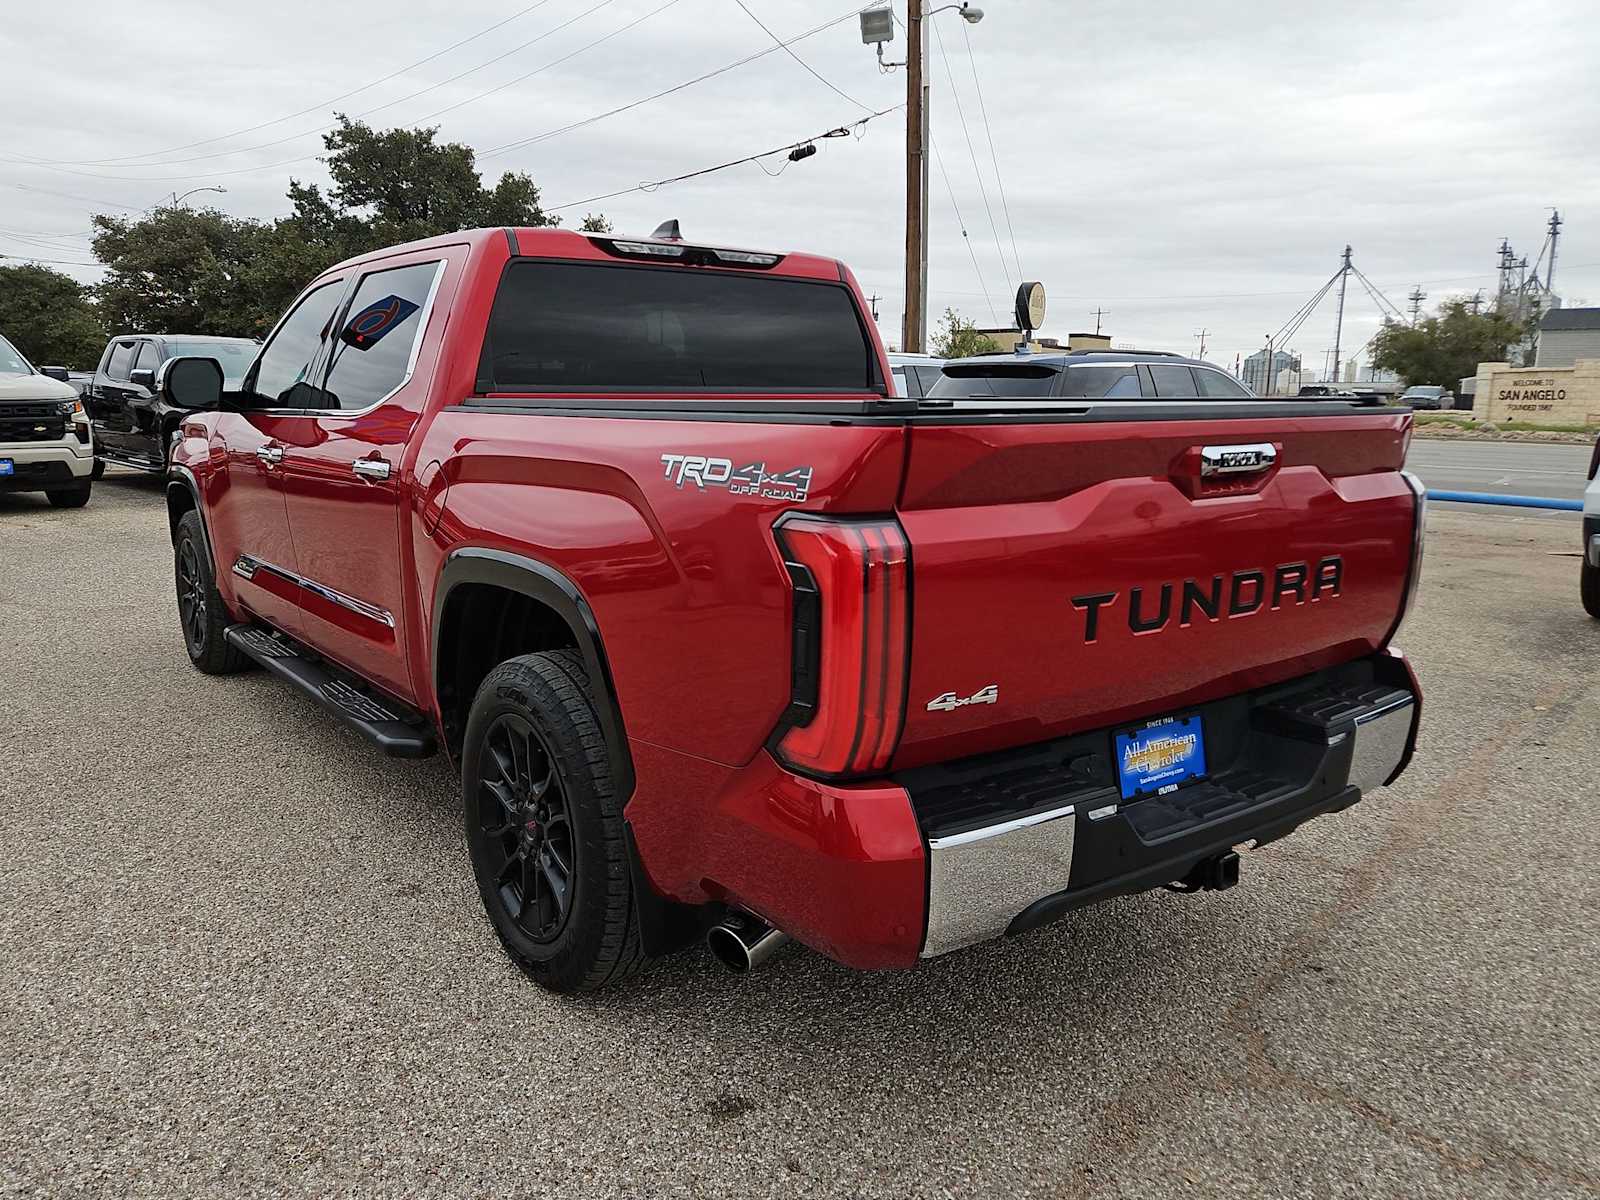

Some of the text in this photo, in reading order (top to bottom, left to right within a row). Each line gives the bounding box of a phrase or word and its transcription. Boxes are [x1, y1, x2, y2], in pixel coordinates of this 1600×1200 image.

[1498, 389, 1567, 401] SAN ANGELO
[661, 453, 733, 489] TRD
[729, 484, 807, 503] OFF ROAD
[1071, 554, 1344, 645] TUNDRA
[926, 684, 999, 712] 4x4
[1124, 733, 1197, 760] All American
[1135, 748, 1185, 773] Chevrolet
